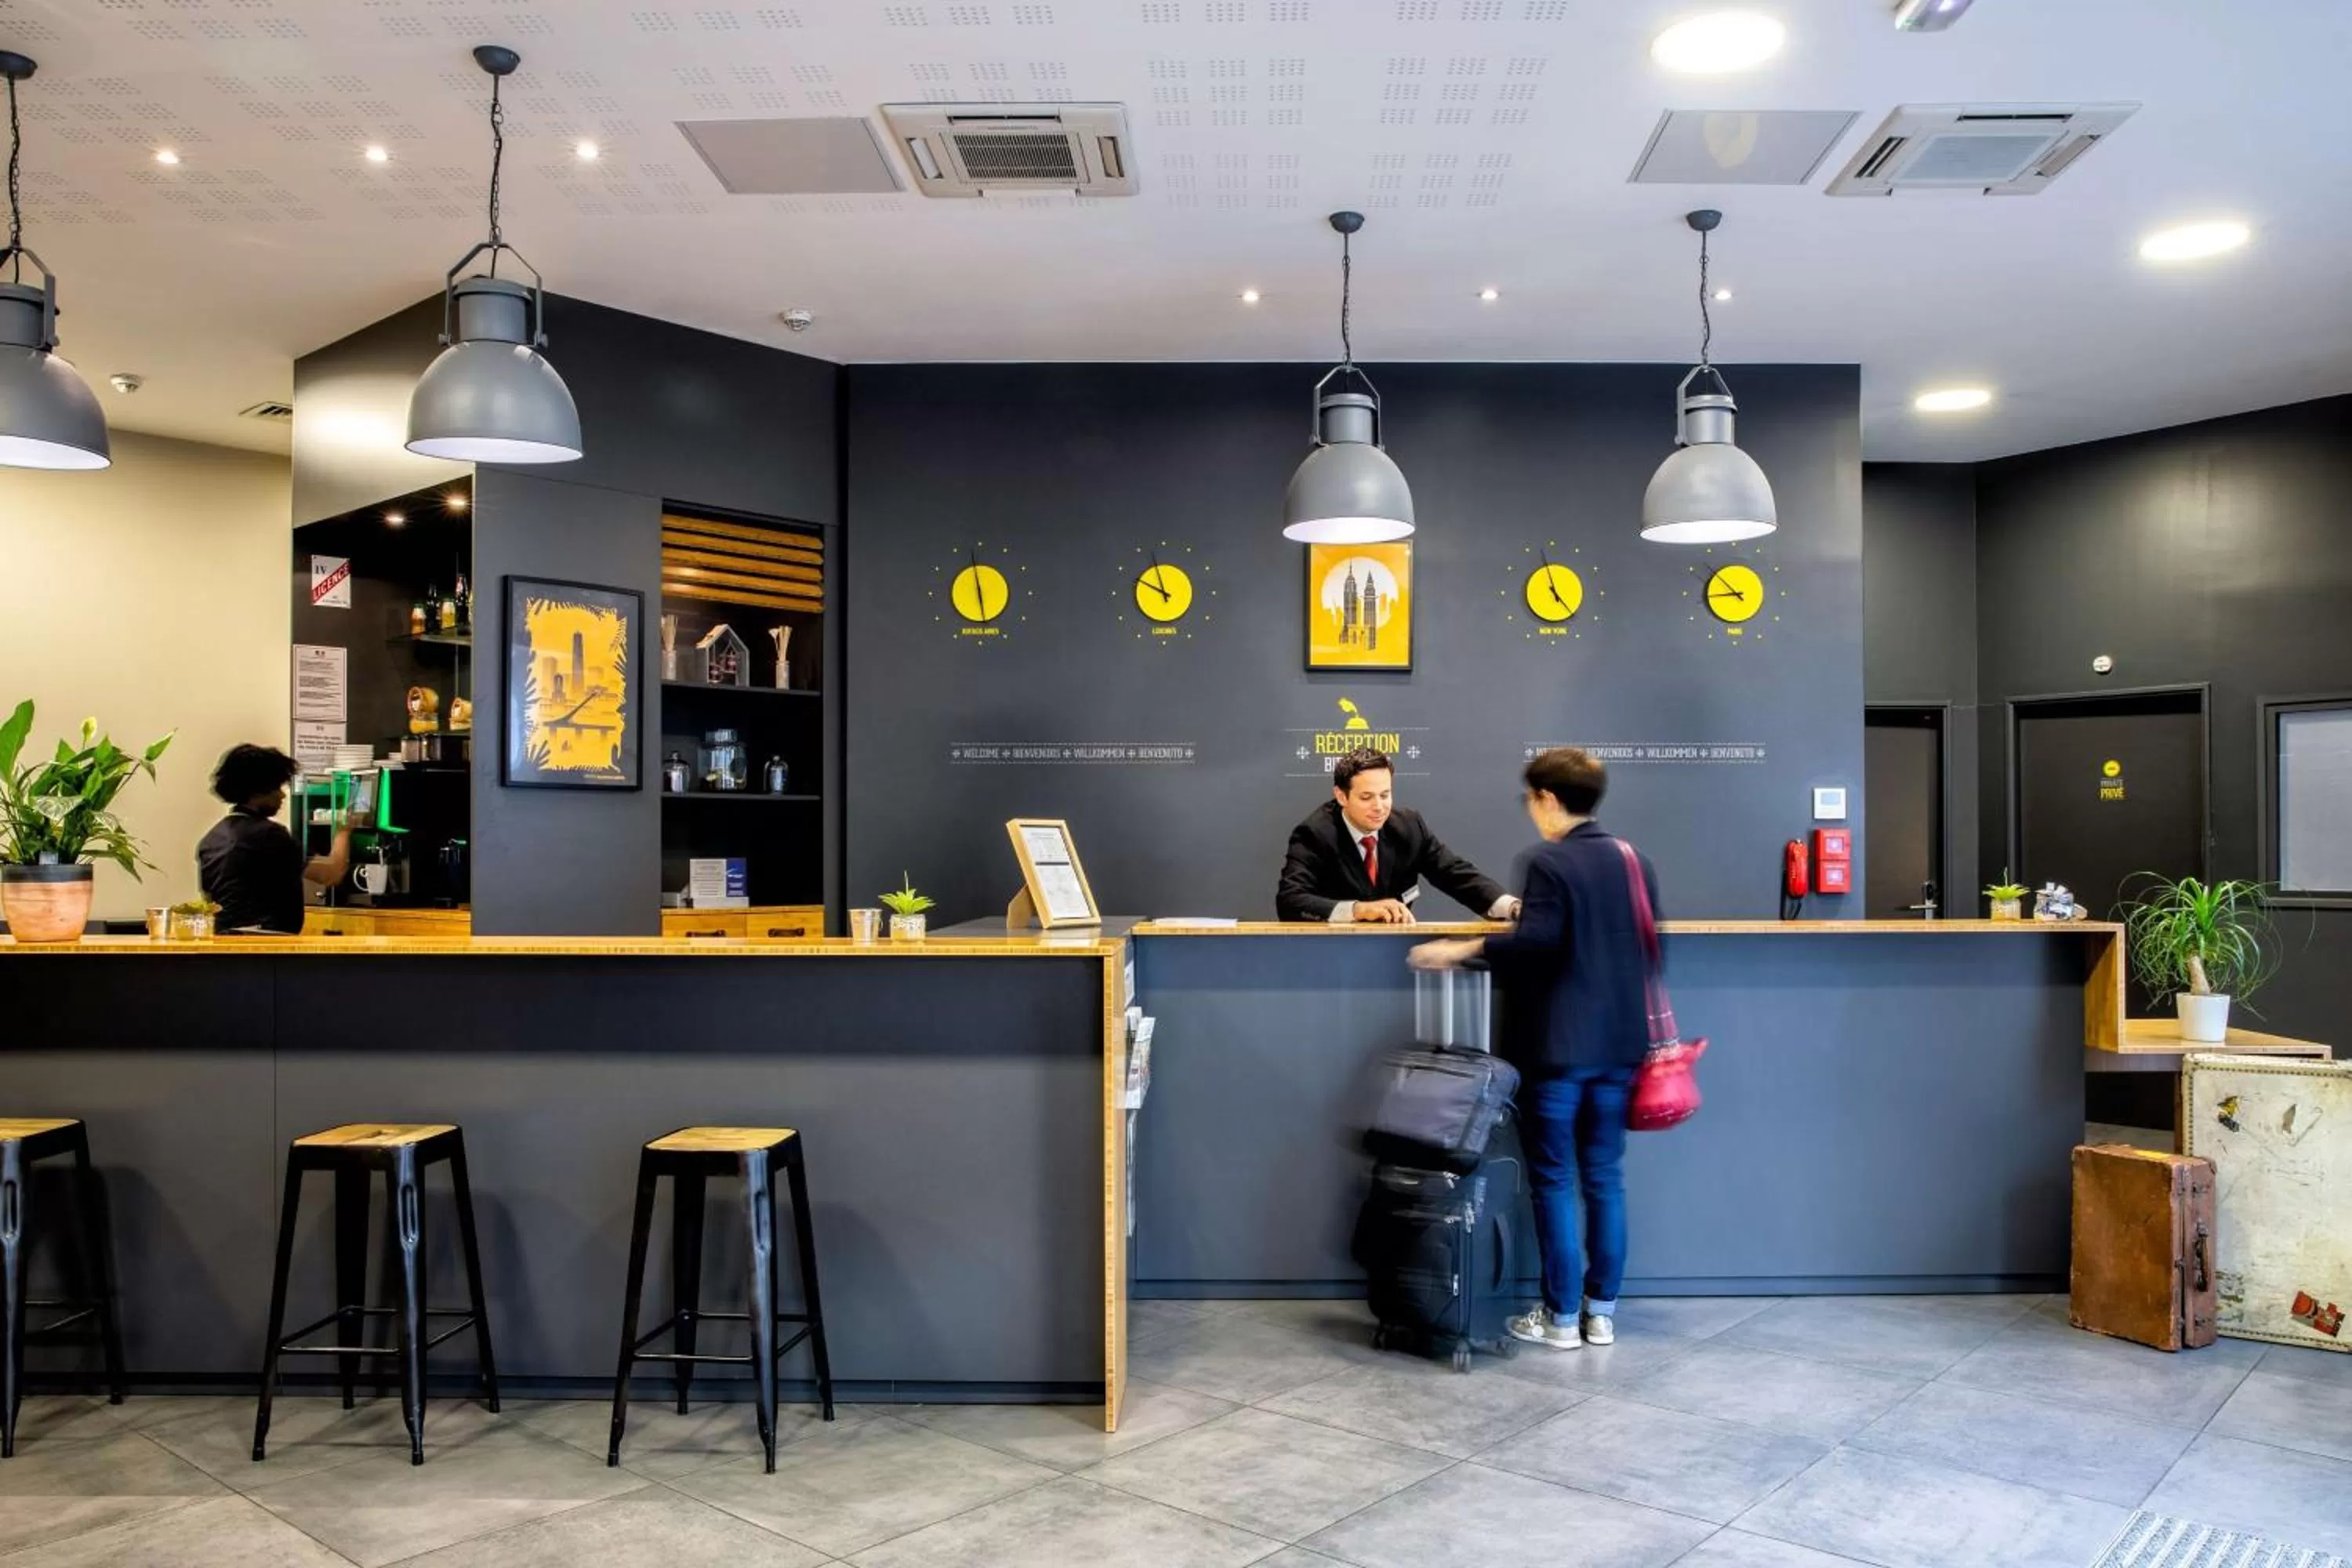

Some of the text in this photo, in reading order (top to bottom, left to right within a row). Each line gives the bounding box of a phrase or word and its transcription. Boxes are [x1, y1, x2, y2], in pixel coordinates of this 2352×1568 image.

[315, 564, 327, 574] IV
[313, 562, 350, 601] LICENCE
[1316, 731, 1399, 753] RÉCEPTION
[964, 748, 999, 758] WELCOME
[1074, 747, 1125, 758] WILLKOMMEN
[1647, 747, 1697, 758] WILLKOMMEN
[2100, 786, 2124, 799] PRIVÉ
